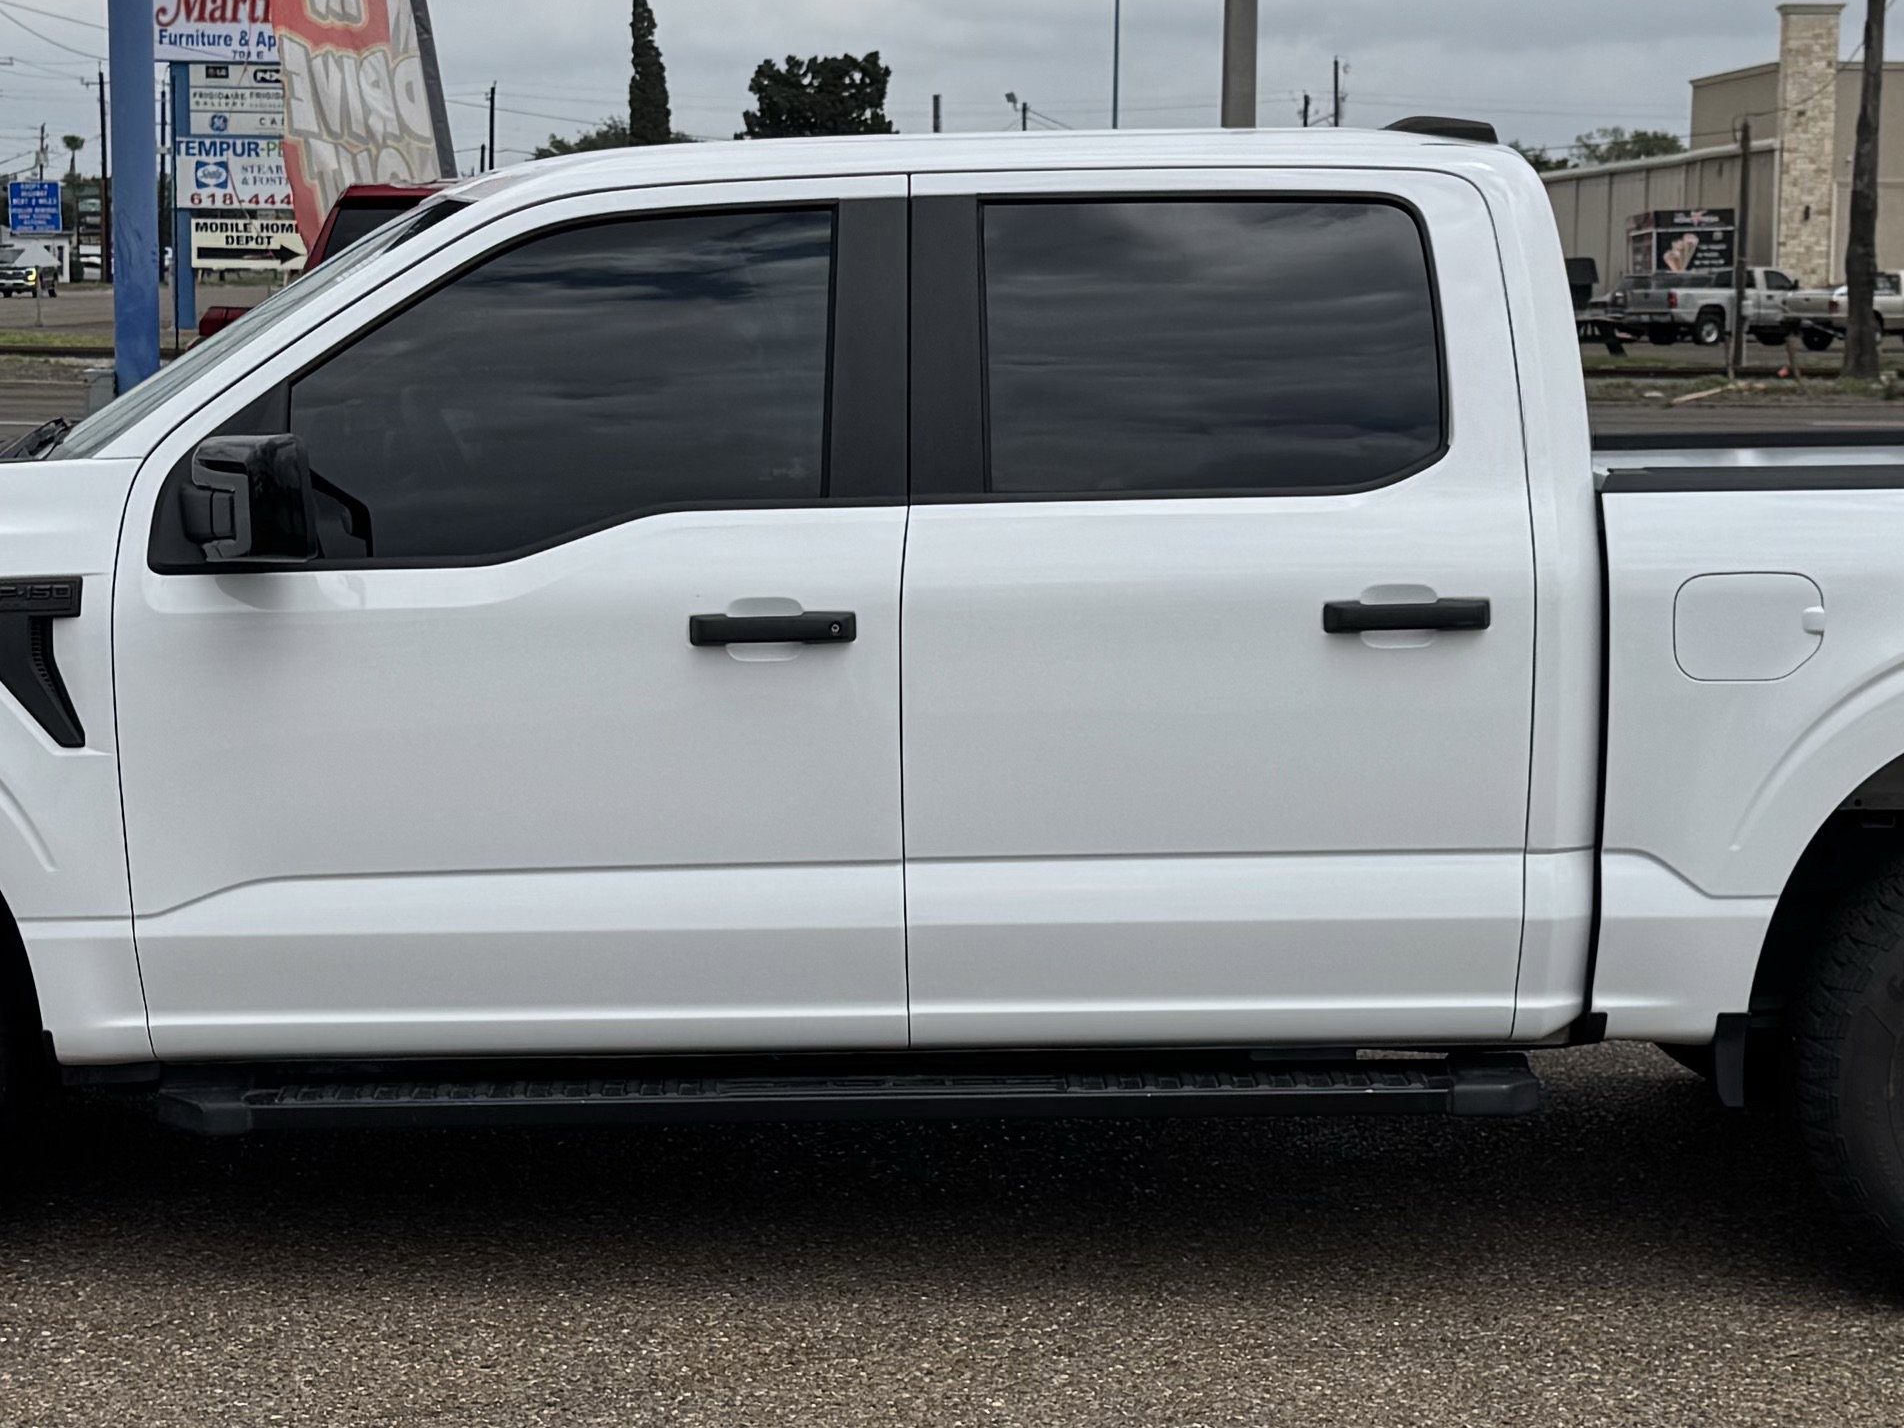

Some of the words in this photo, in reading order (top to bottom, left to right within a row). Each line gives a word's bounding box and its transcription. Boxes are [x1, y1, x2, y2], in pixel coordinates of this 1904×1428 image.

[158, 29, 233, 47] Furniture
[239, 30, 249, 47] &
[195, 222, 252, 233] MOBILE
[225, 235, 274, 246] DEPOT
